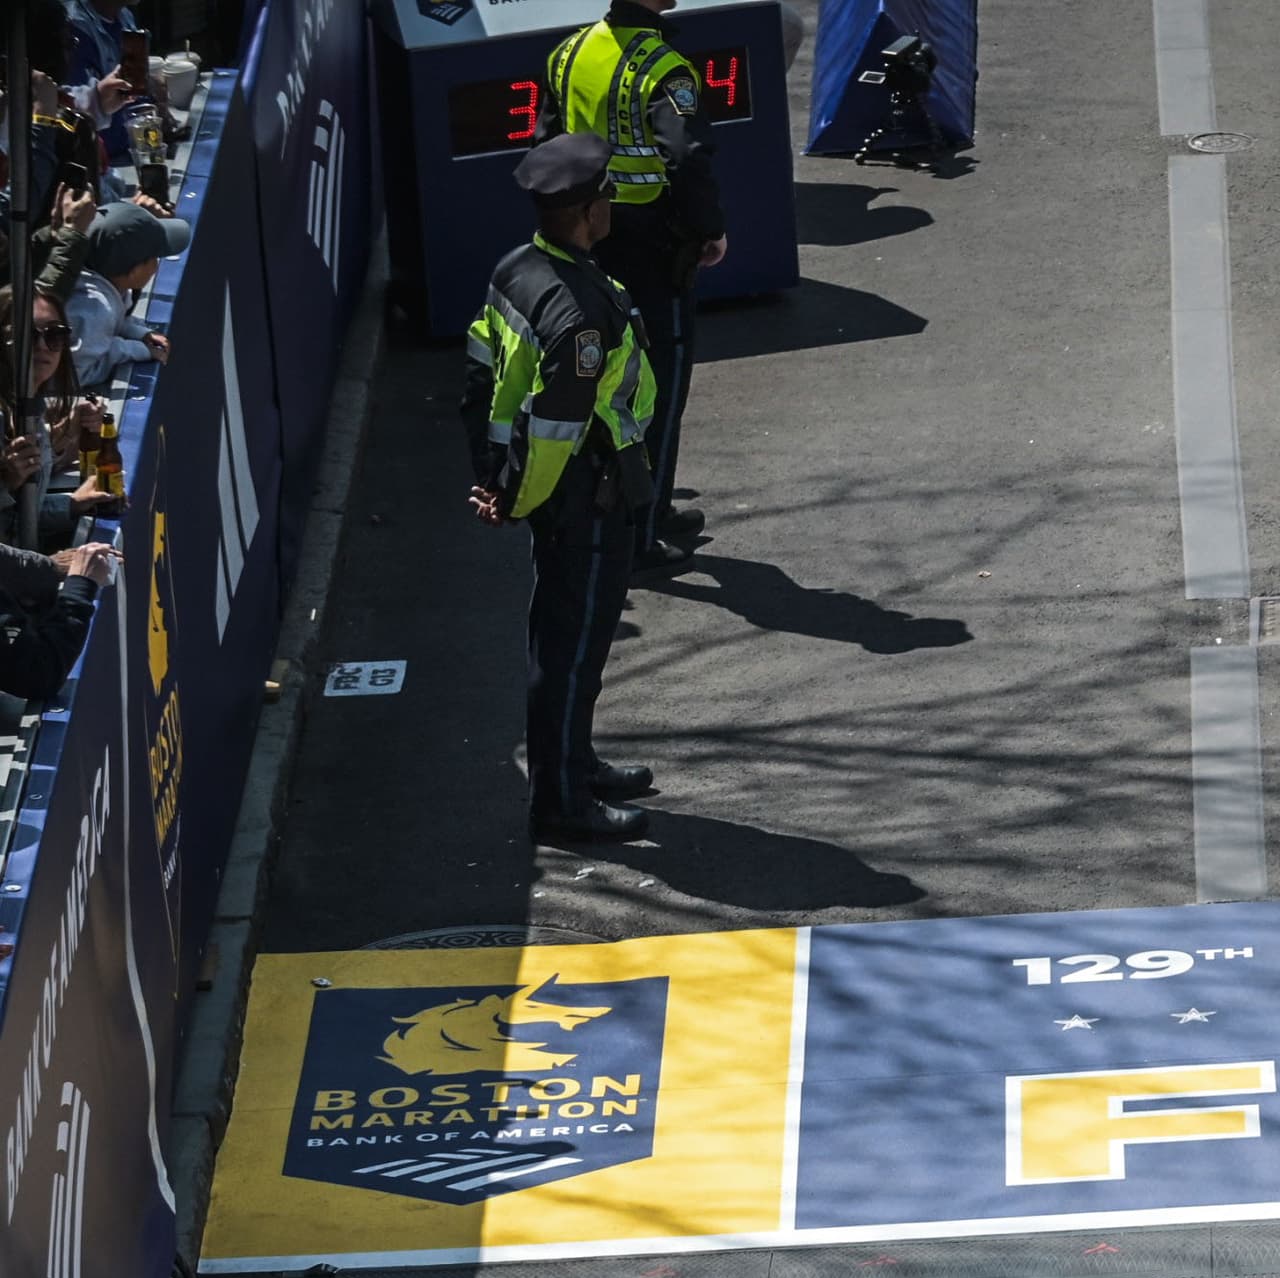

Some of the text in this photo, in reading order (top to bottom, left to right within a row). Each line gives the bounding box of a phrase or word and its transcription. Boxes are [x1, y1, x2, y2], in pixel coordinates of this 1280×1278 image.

[508, 57, 738, 141] 3 4
[617, 47, 647, 135] POLICE
[7, 1010, 42, 1226] BANK
[309, 1100, 638, 1131] MARATHON
[313, 1074, 642, 1112] BOSTON
[307, 1122, 634, 1147] BANK OF AMERICA
